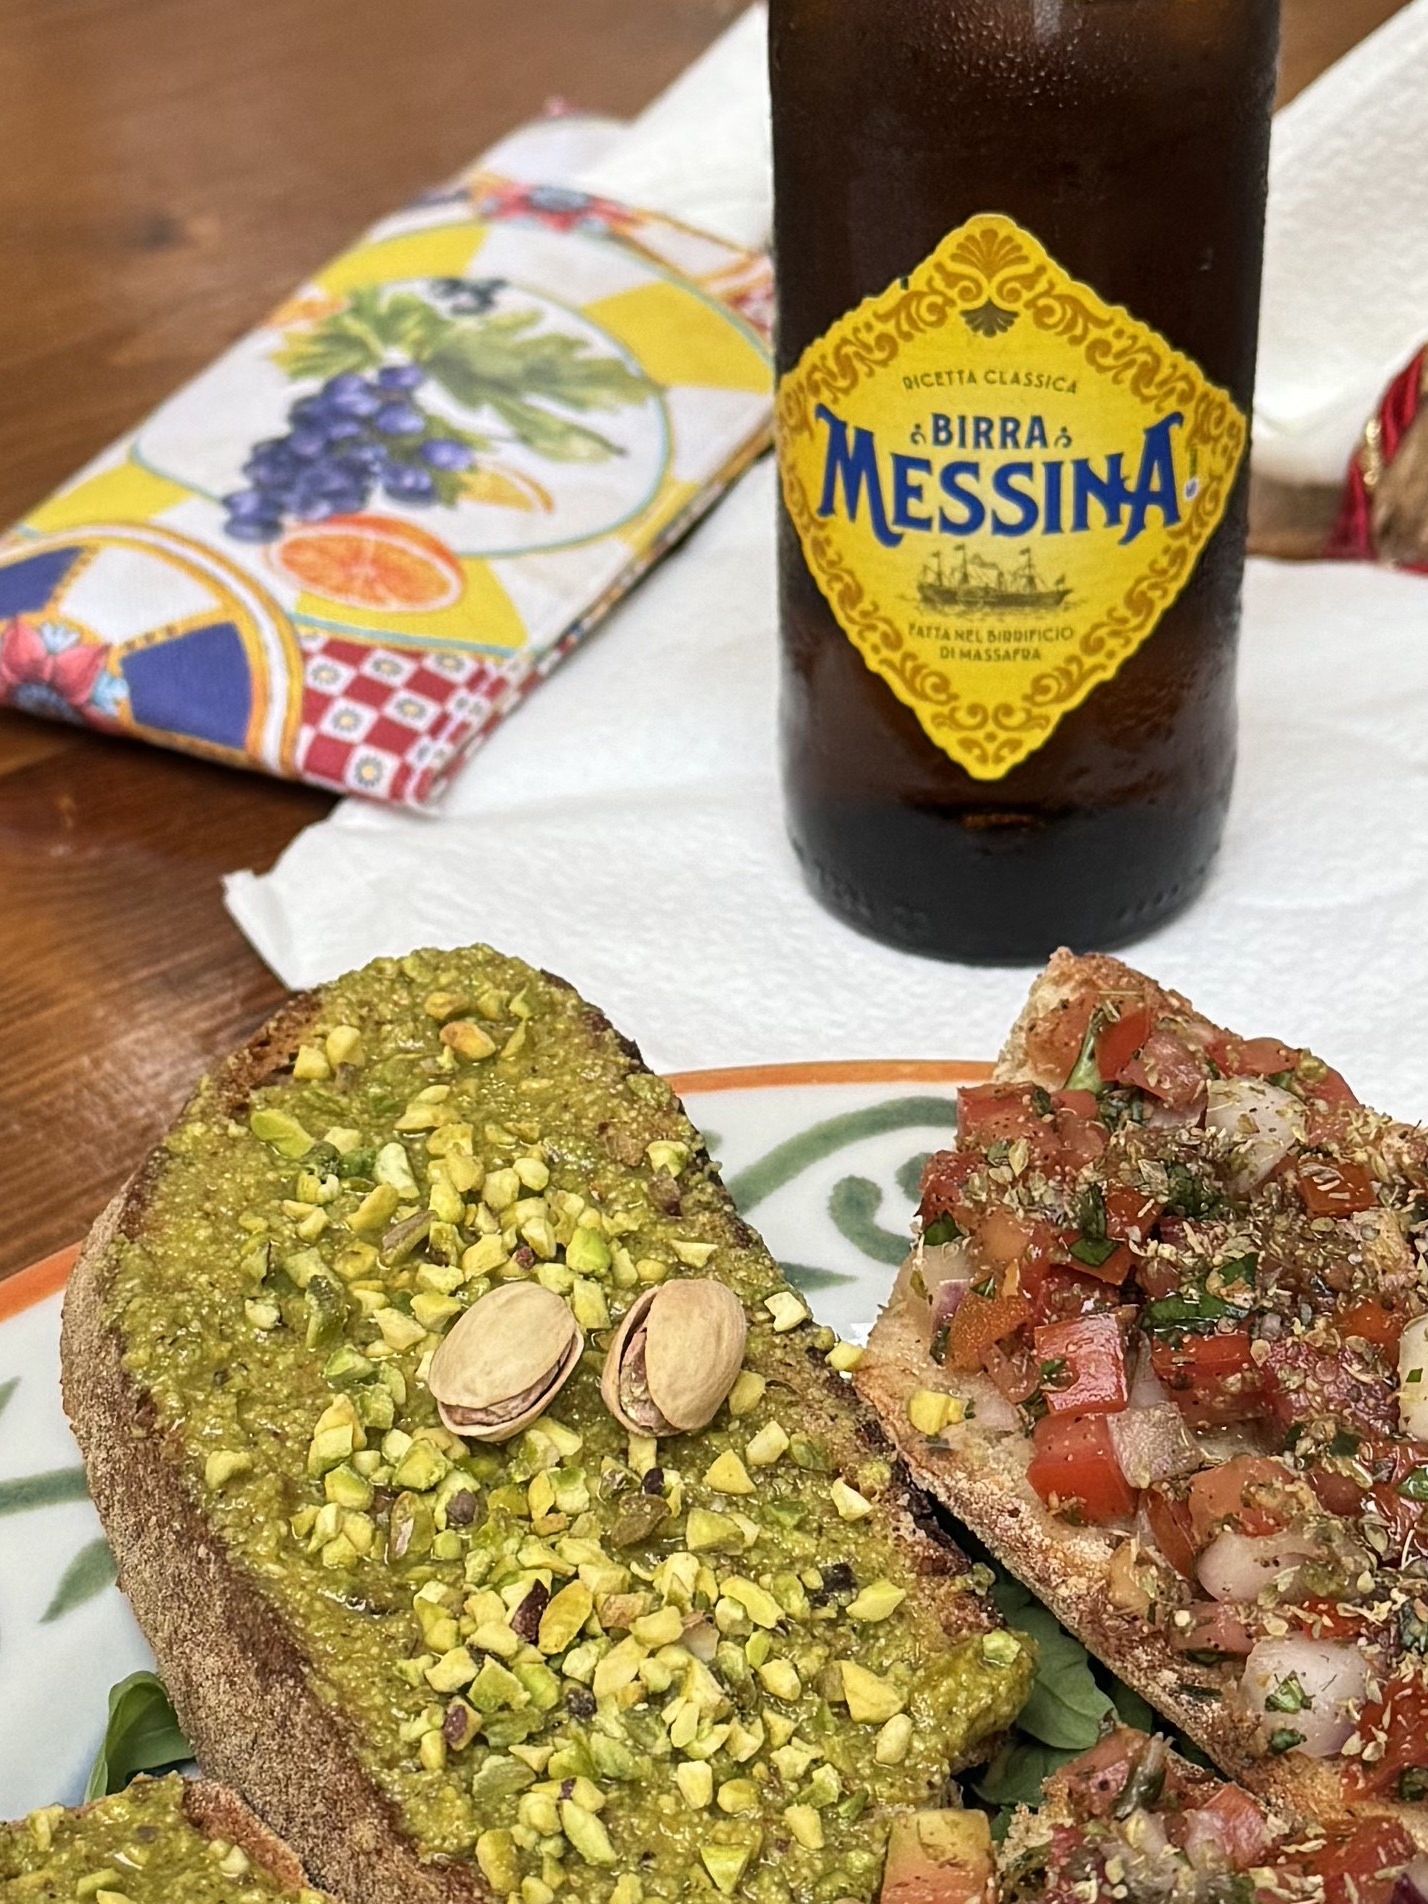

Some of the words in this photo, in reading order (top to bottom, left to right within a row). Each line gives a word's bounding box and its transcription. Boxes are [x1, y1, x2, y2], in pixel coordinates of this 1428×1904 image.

[902, 369, 977, 391] RICETTA
[984, 369, 1077, 394] CLASSICA
[931, 412, 1049, 450] BIRRA
[814, 402, 1184, 548] MESSINA
[909, 623, 951, 642] FATTA
[954, 629, 984, 643] NEL
[987, 626, 1074, 644] BIRRIFICIO
[940, 646, 956, 660] DI
[960, 647, 1041, 662] MASSAFRA
